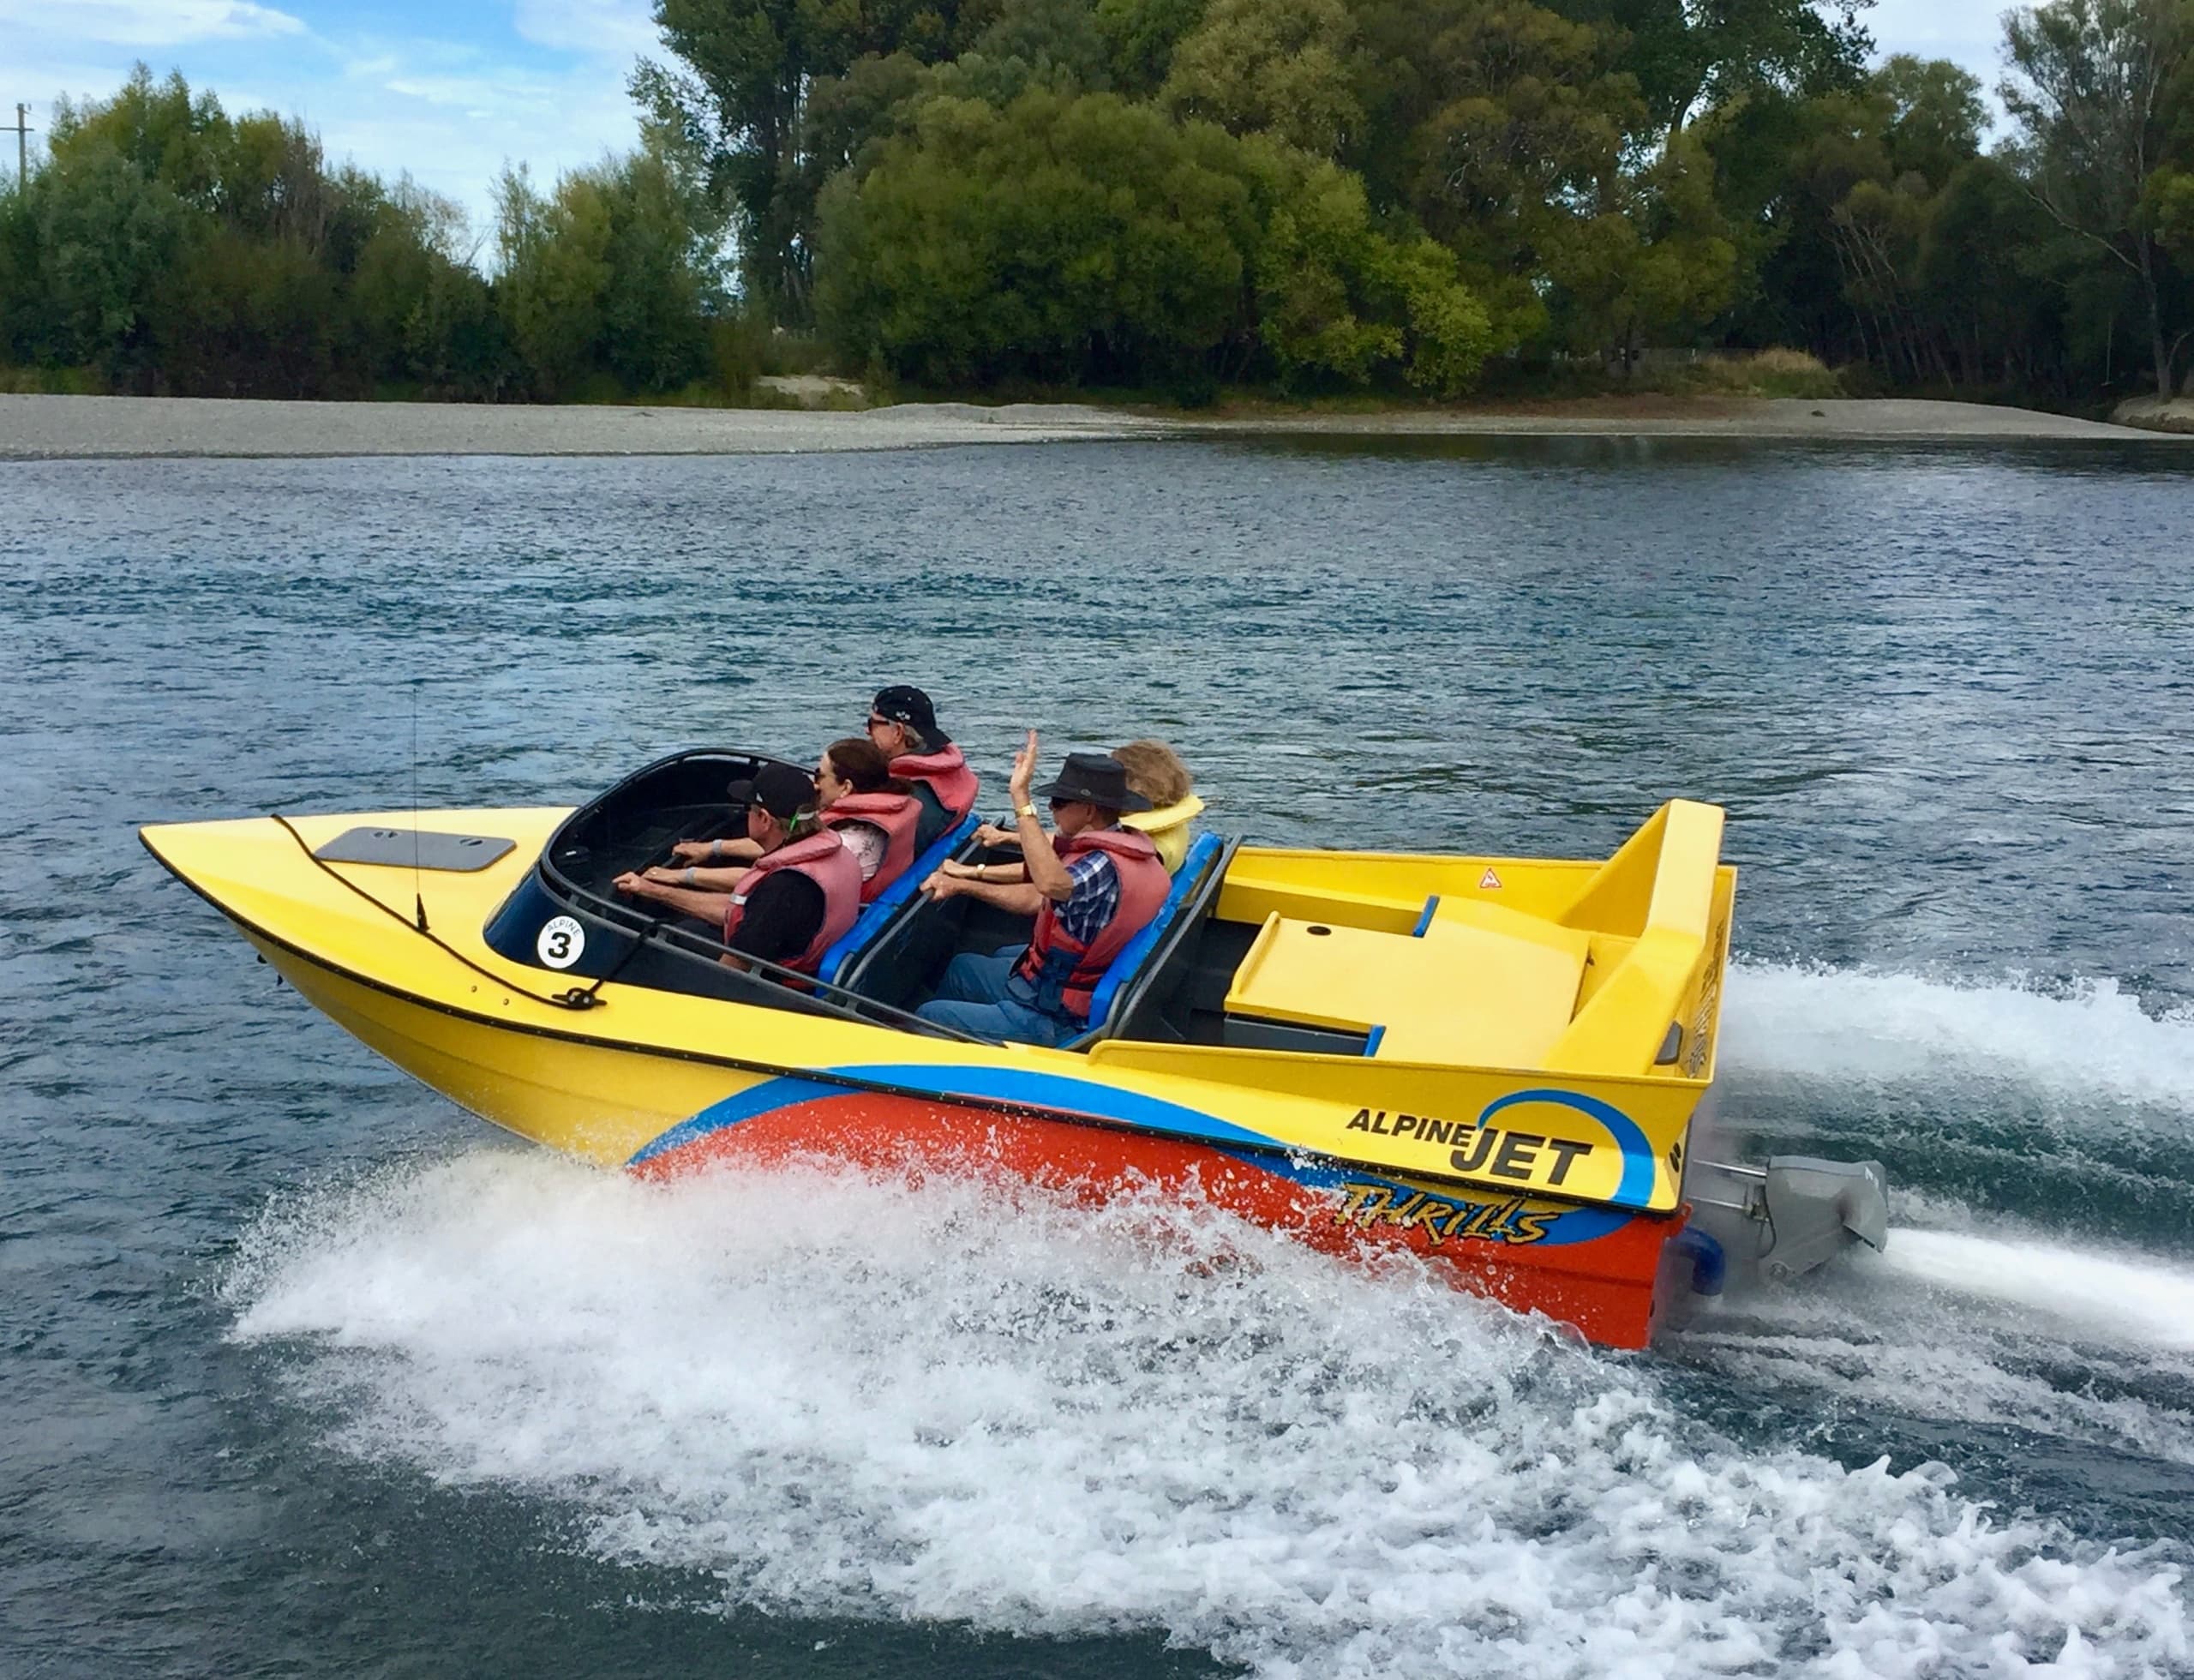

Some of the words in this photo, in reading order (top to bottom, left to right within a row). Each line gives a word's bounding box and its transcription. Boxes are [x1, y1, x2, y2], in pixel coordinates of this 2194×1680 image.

[548, 919, 581, 936] ALPINE
[548, 932, 571, 958] 3
[1346, 1108, 1478, 1147] ALPINE
[1450, 1127, 1593, 1185] JET
